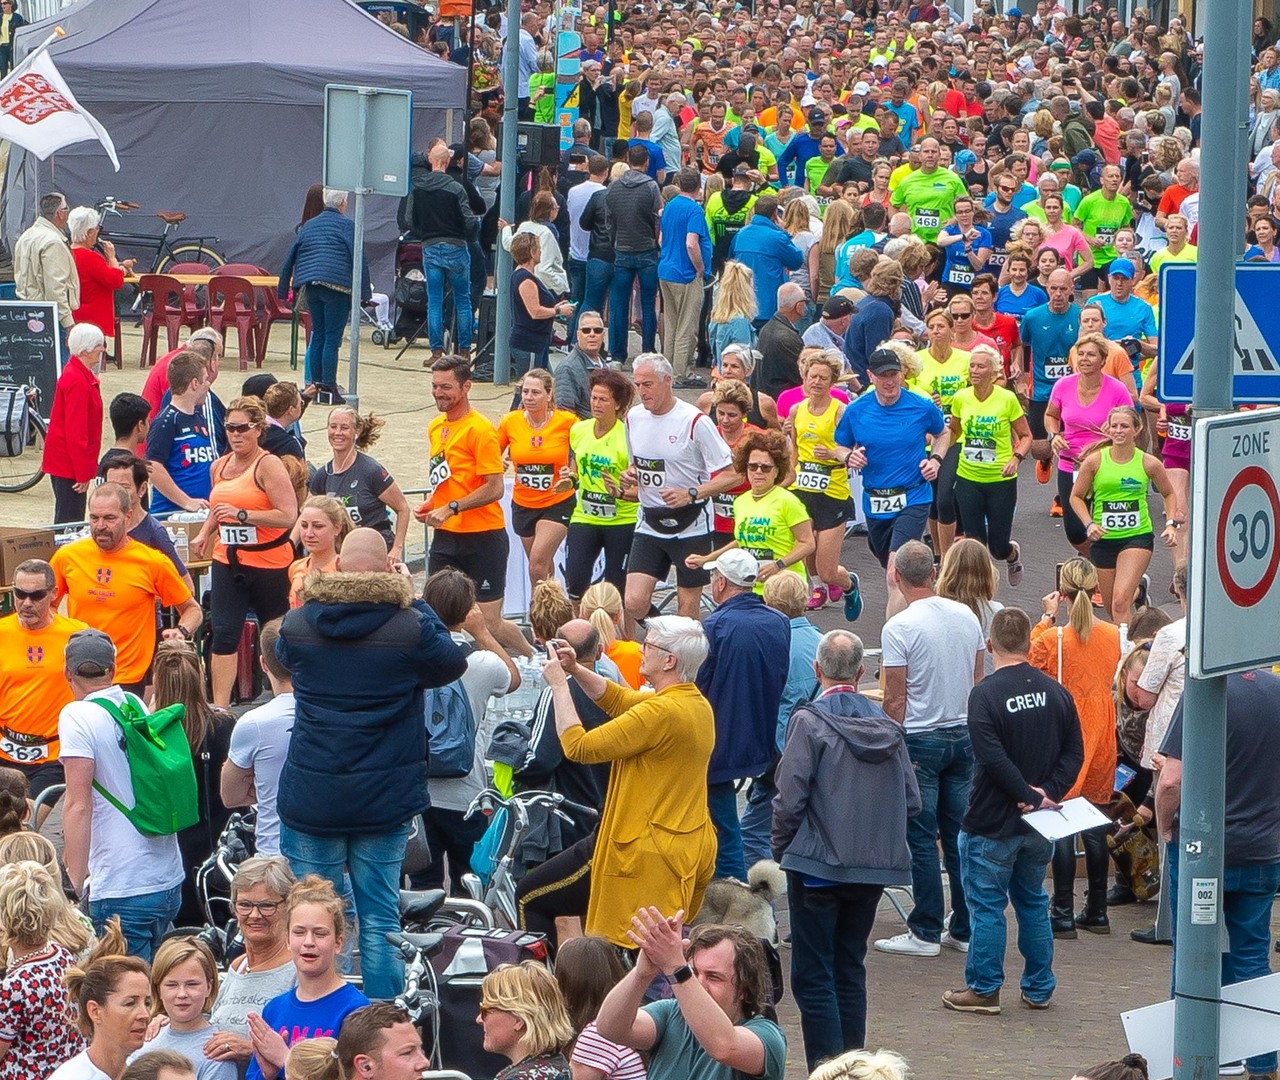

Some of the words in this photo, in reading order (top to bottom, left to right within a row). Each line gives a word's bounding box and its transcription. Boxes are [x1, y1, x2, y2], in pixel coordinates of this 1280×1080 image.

[917, 217, 938, 227] 468
[952, 273, 970, 283] 150
[1169, 425, 1189, 439] 833
[1232, 431, 1270, 458] ZONE
[974, 451, 984, 462] 4
[521, 476, 551, 490] 856
[797, 474, 829, 490] 1056
[591, 504, 606, 516] 31
[873, 497, 904, 512] 724
[1107, 501, 1135, 511] RUNX
[1106, 514, 1137, 528] 638
[225, 529, 249, 543] 115
[1230, 509, 1270, 564] 30
[1006, 692, 1046, 713] CREW
[3, 744, 44, 762] 262
[1197, 890, 1213, 900] 002
